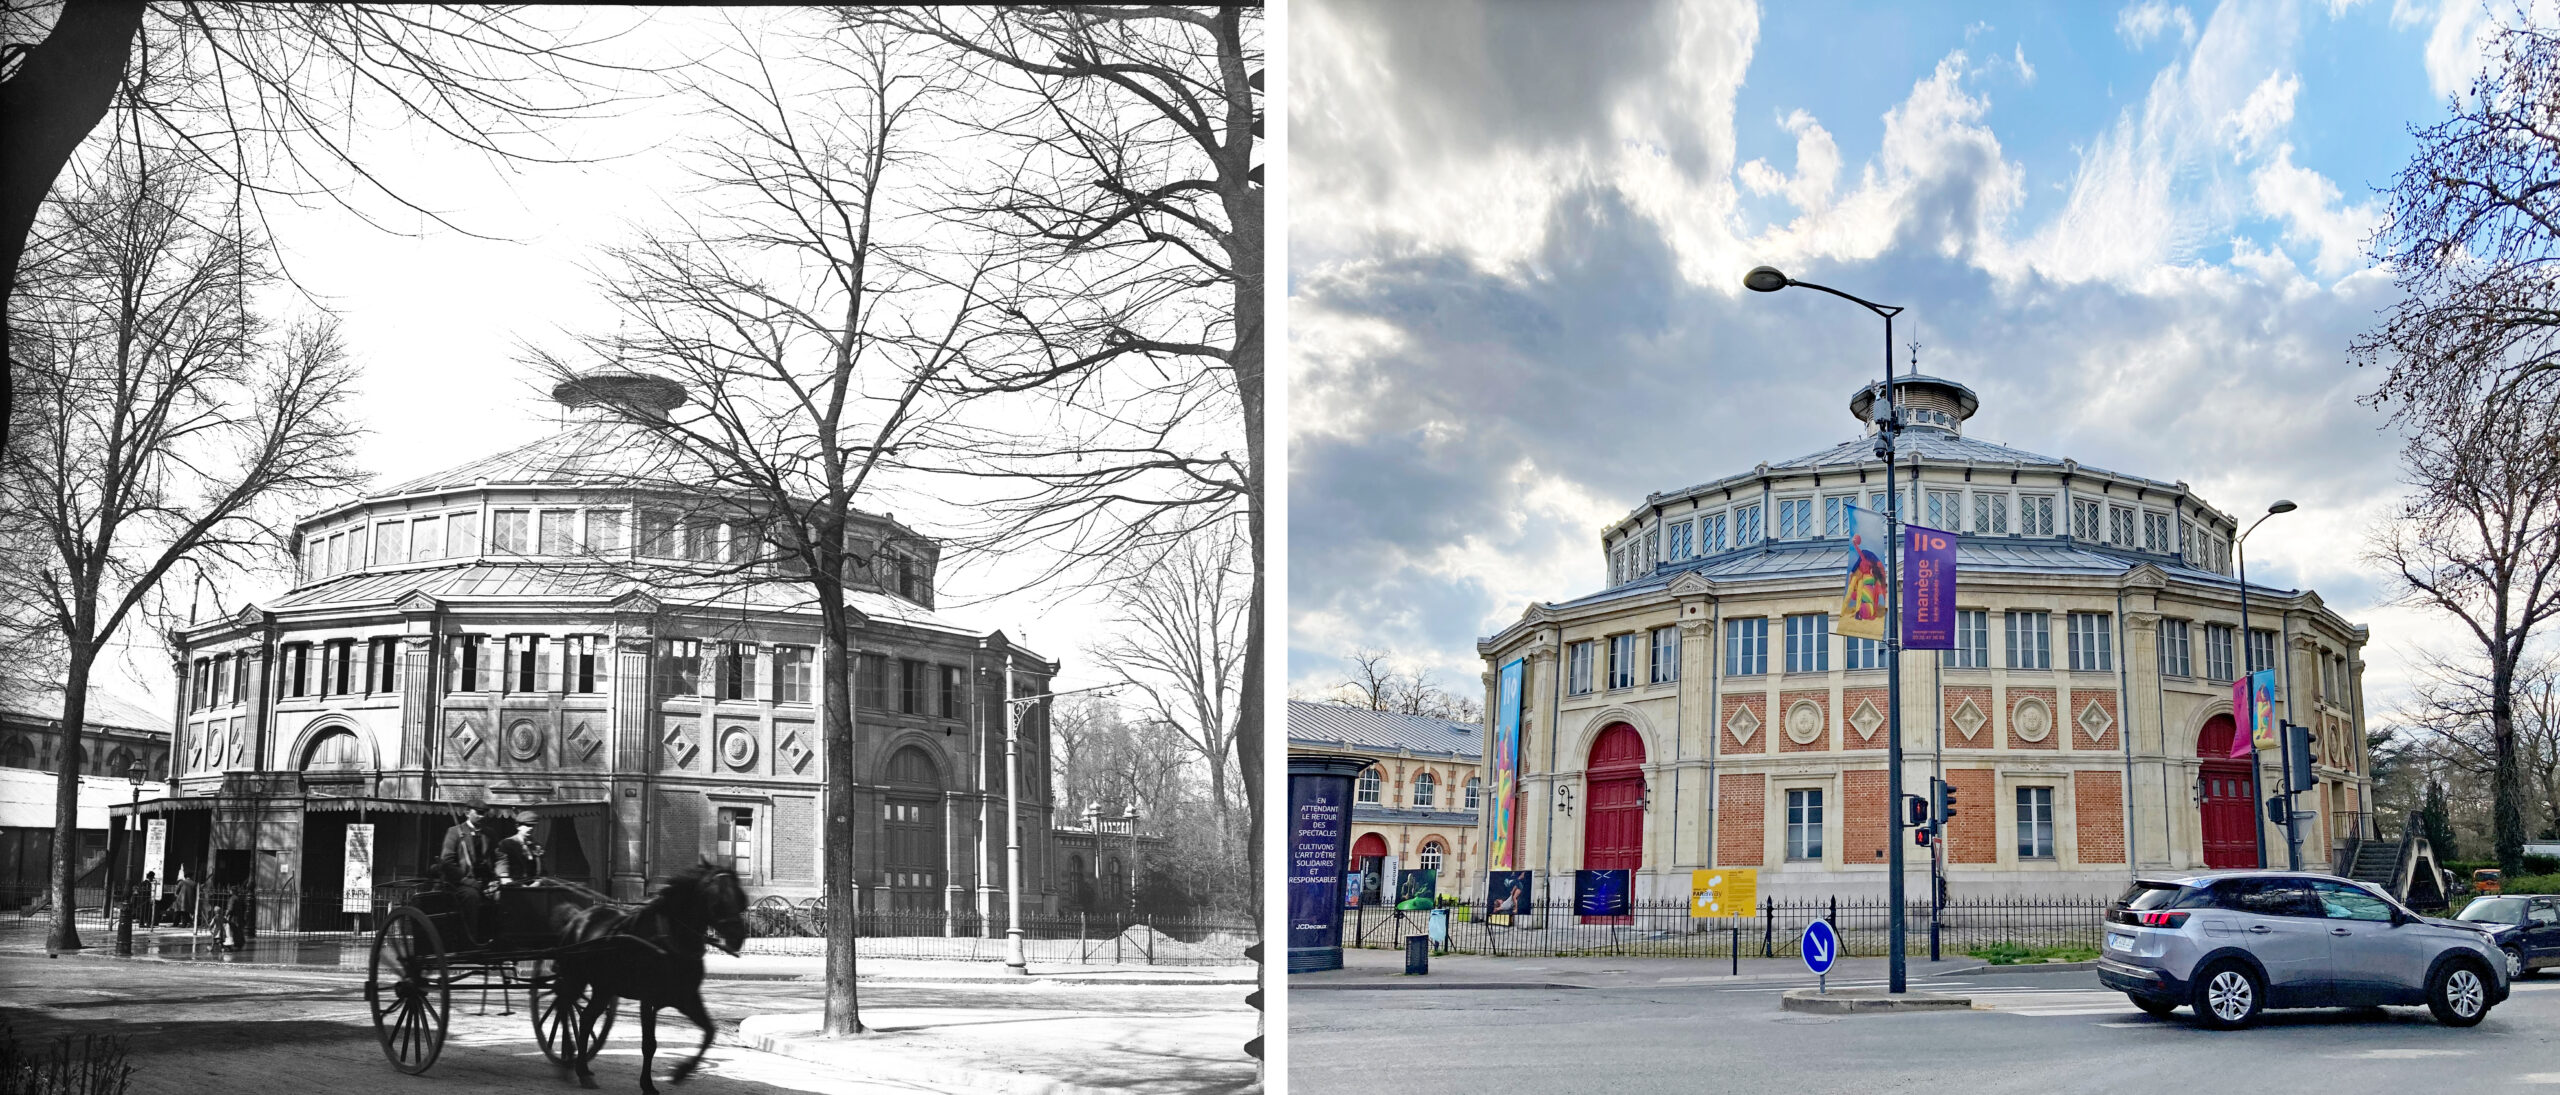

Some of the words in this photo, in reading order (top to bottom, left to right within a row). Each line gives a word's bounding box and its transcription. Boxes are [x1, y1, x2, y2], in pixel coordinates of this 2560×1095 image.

[1914, 559, 1933, 623] manège
[1311, 813, 1337, 821] RETOUR
[1298, 829, 1337, 837] SPECTACLES
[1298, 843, 1335, 851] CULTIVONS
[1294, 851, 1314, 859] L'ART
[1314, 851, 1337, 859] D'ÊTRE
[1296, 859, 1334, 867] SOLIDAIRES
[1288, 876, 1337, 884] RESPONSABLES
